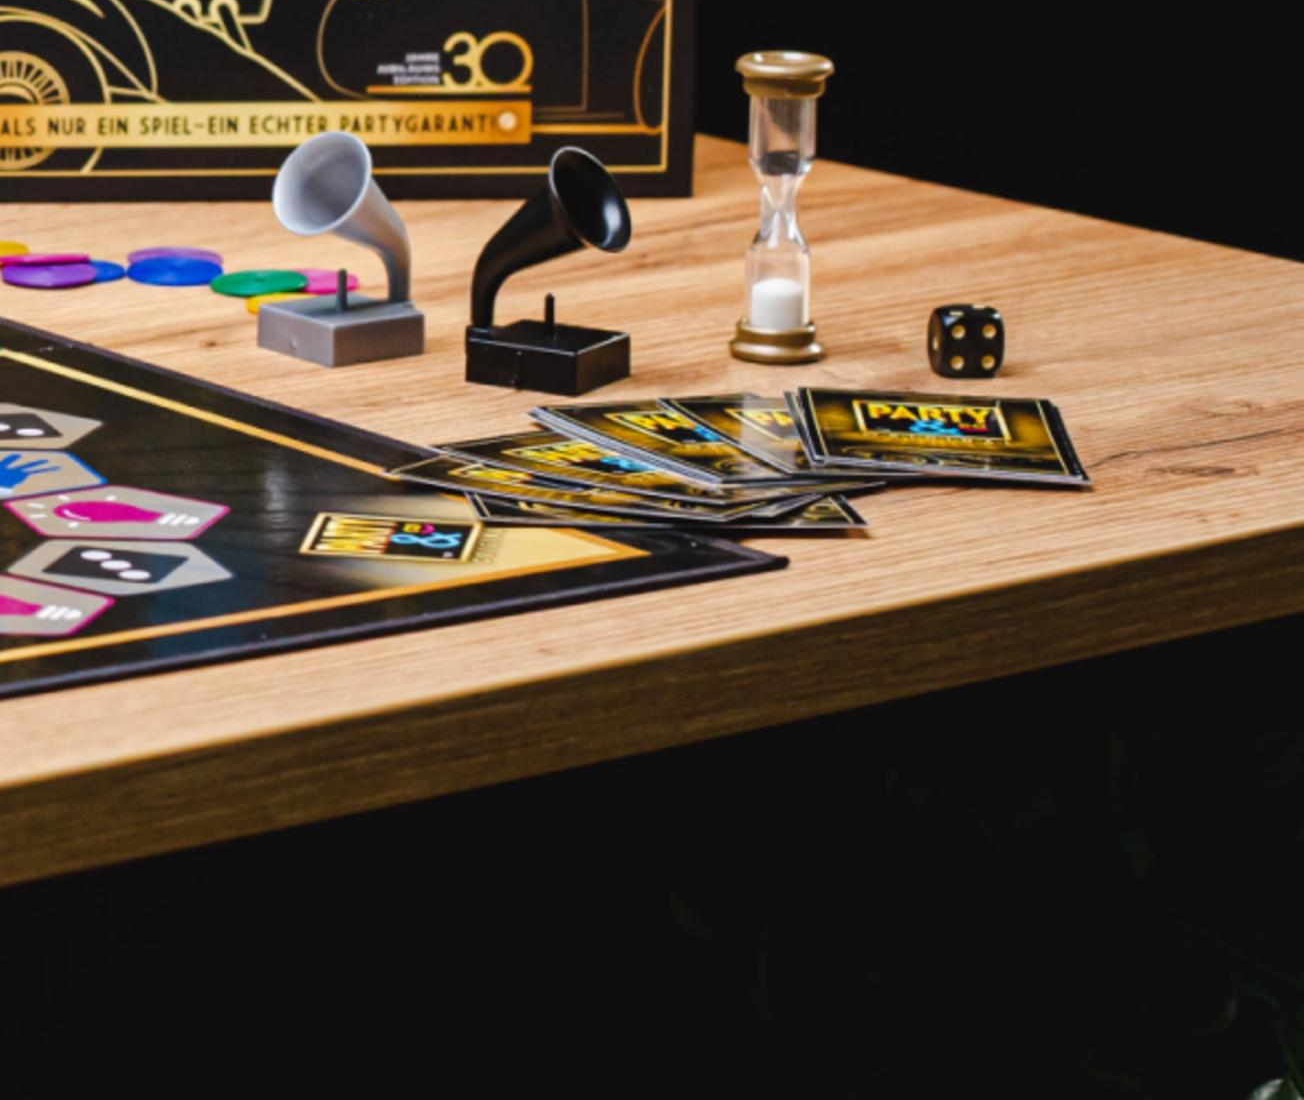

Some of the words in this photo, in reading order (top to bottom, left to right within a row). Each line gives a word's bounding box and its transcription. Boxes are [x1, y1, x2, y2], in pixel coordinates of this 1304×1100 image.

[443, 31, 534, 87] 30
[0, 115, 37, 136] ALS
[47, 116, 86, 136] NUR
[98, 115, 129, 135] EIN
[249, 114, 329, 135] ECHTER
[866, 402, 990, 425] PARTY
